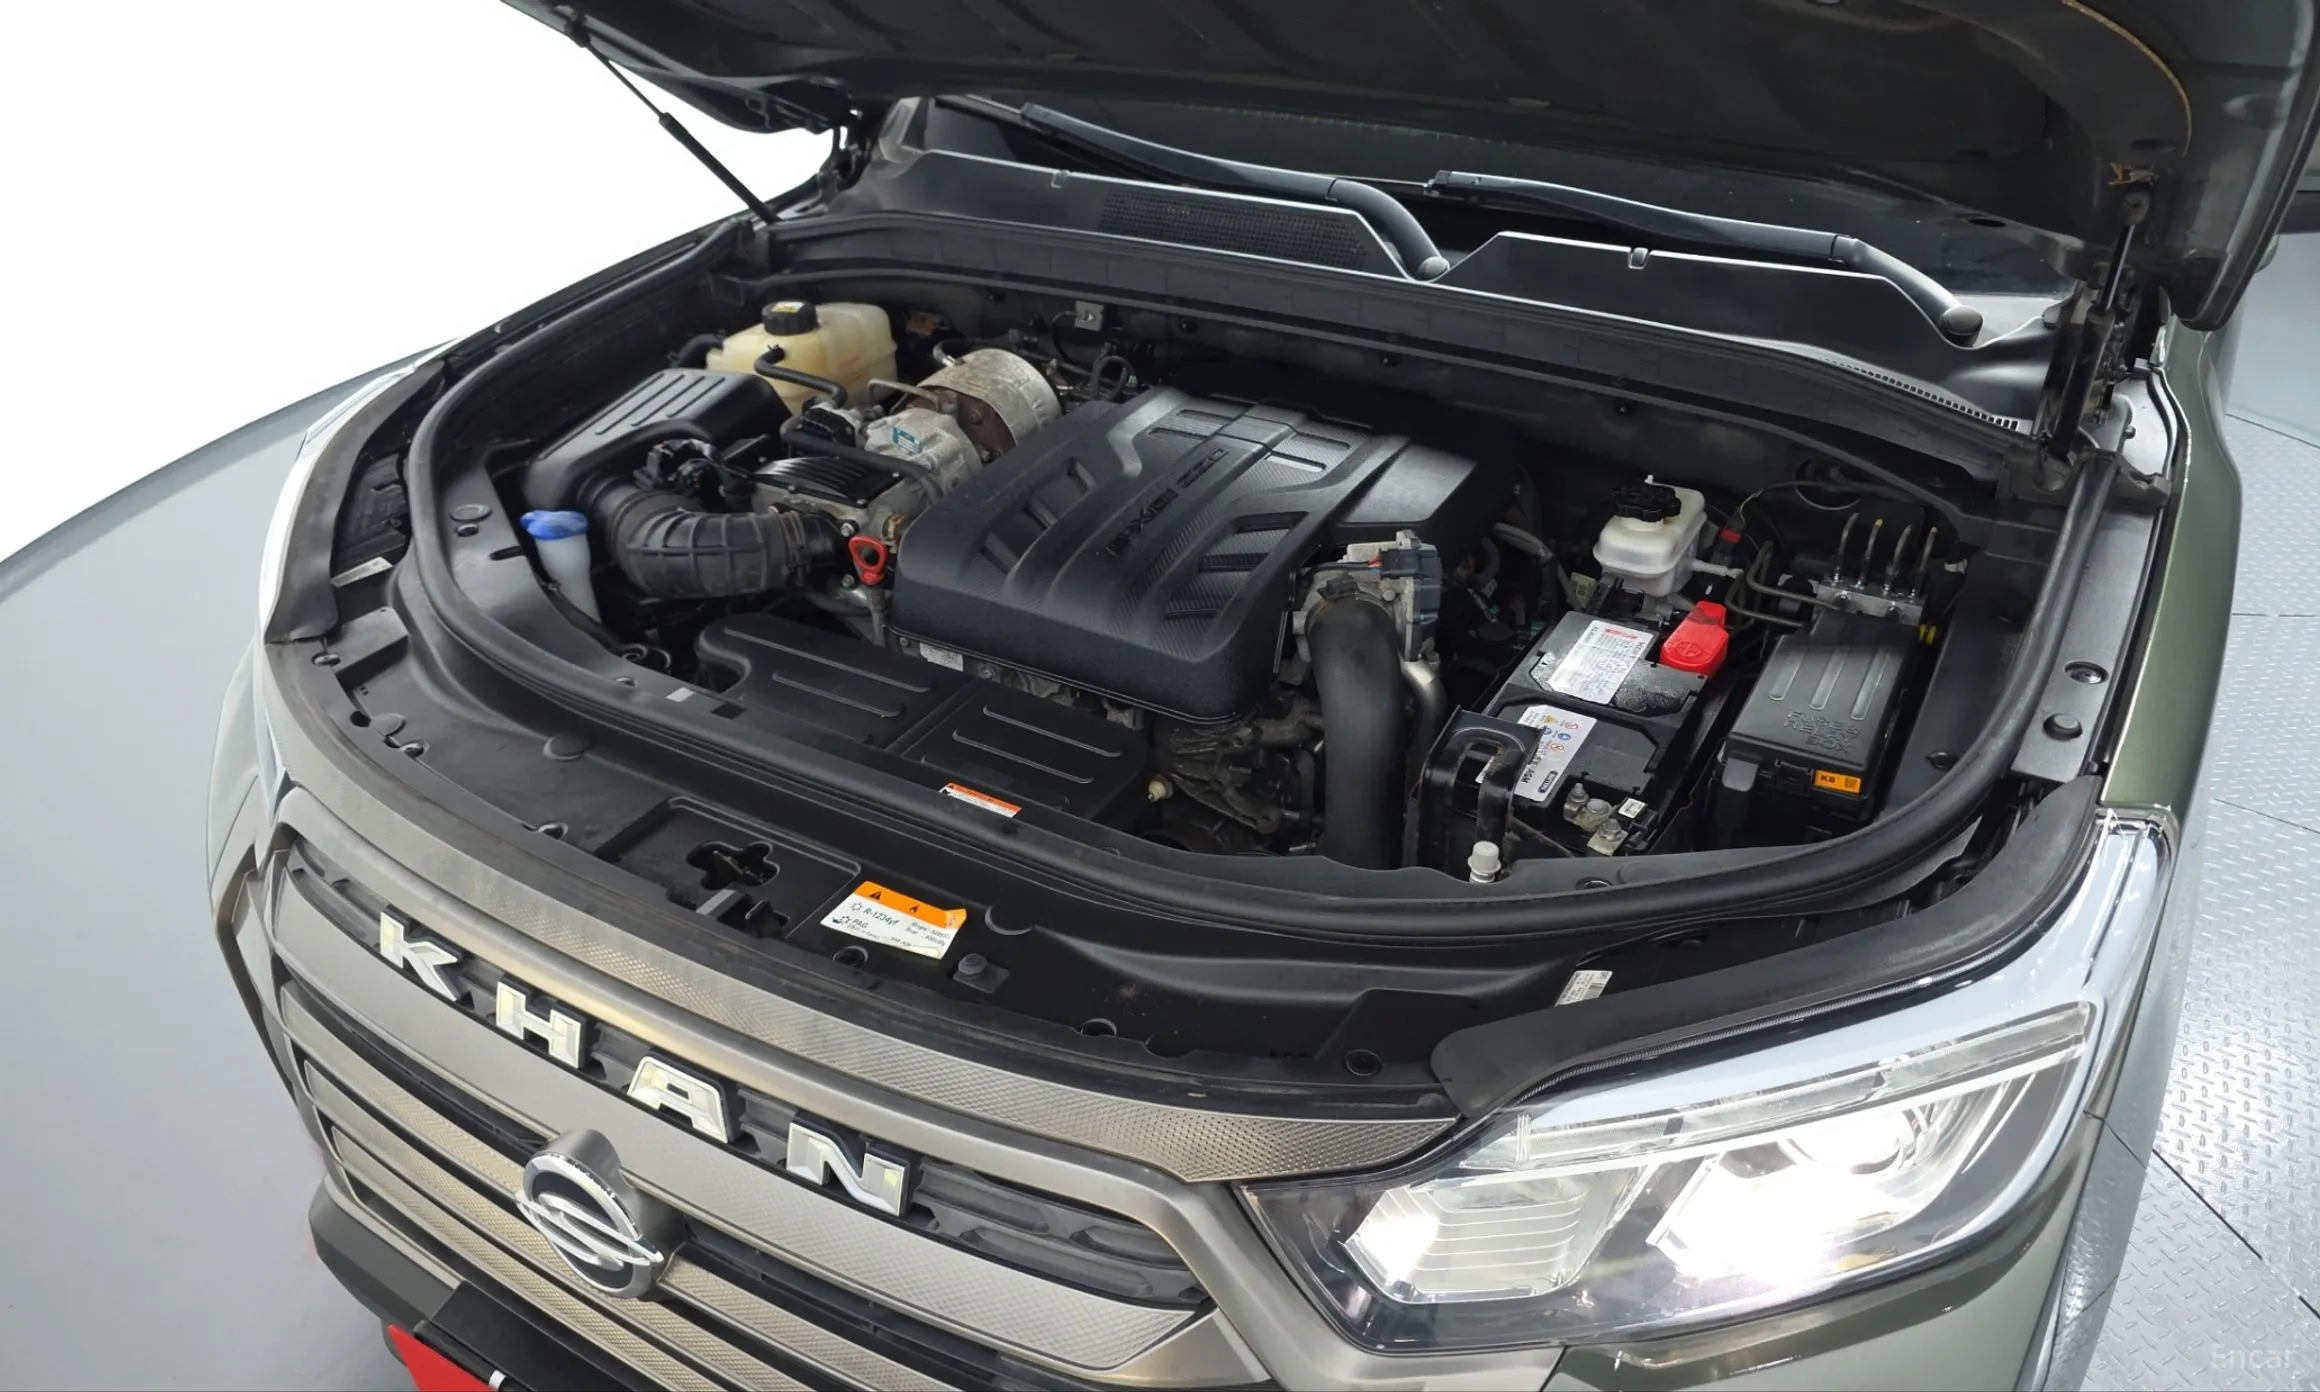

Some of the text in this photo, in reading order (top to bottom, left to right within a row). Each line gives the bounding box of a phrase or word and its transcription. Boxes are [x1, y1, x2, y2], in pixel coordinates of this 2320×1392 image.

[1805, 735, 1849, 754] BOX
[852, 918, 869, 929] PAG
[863, 908, 900, 926] R-1234yf
[380, 911, 905, 1216] KHAN
